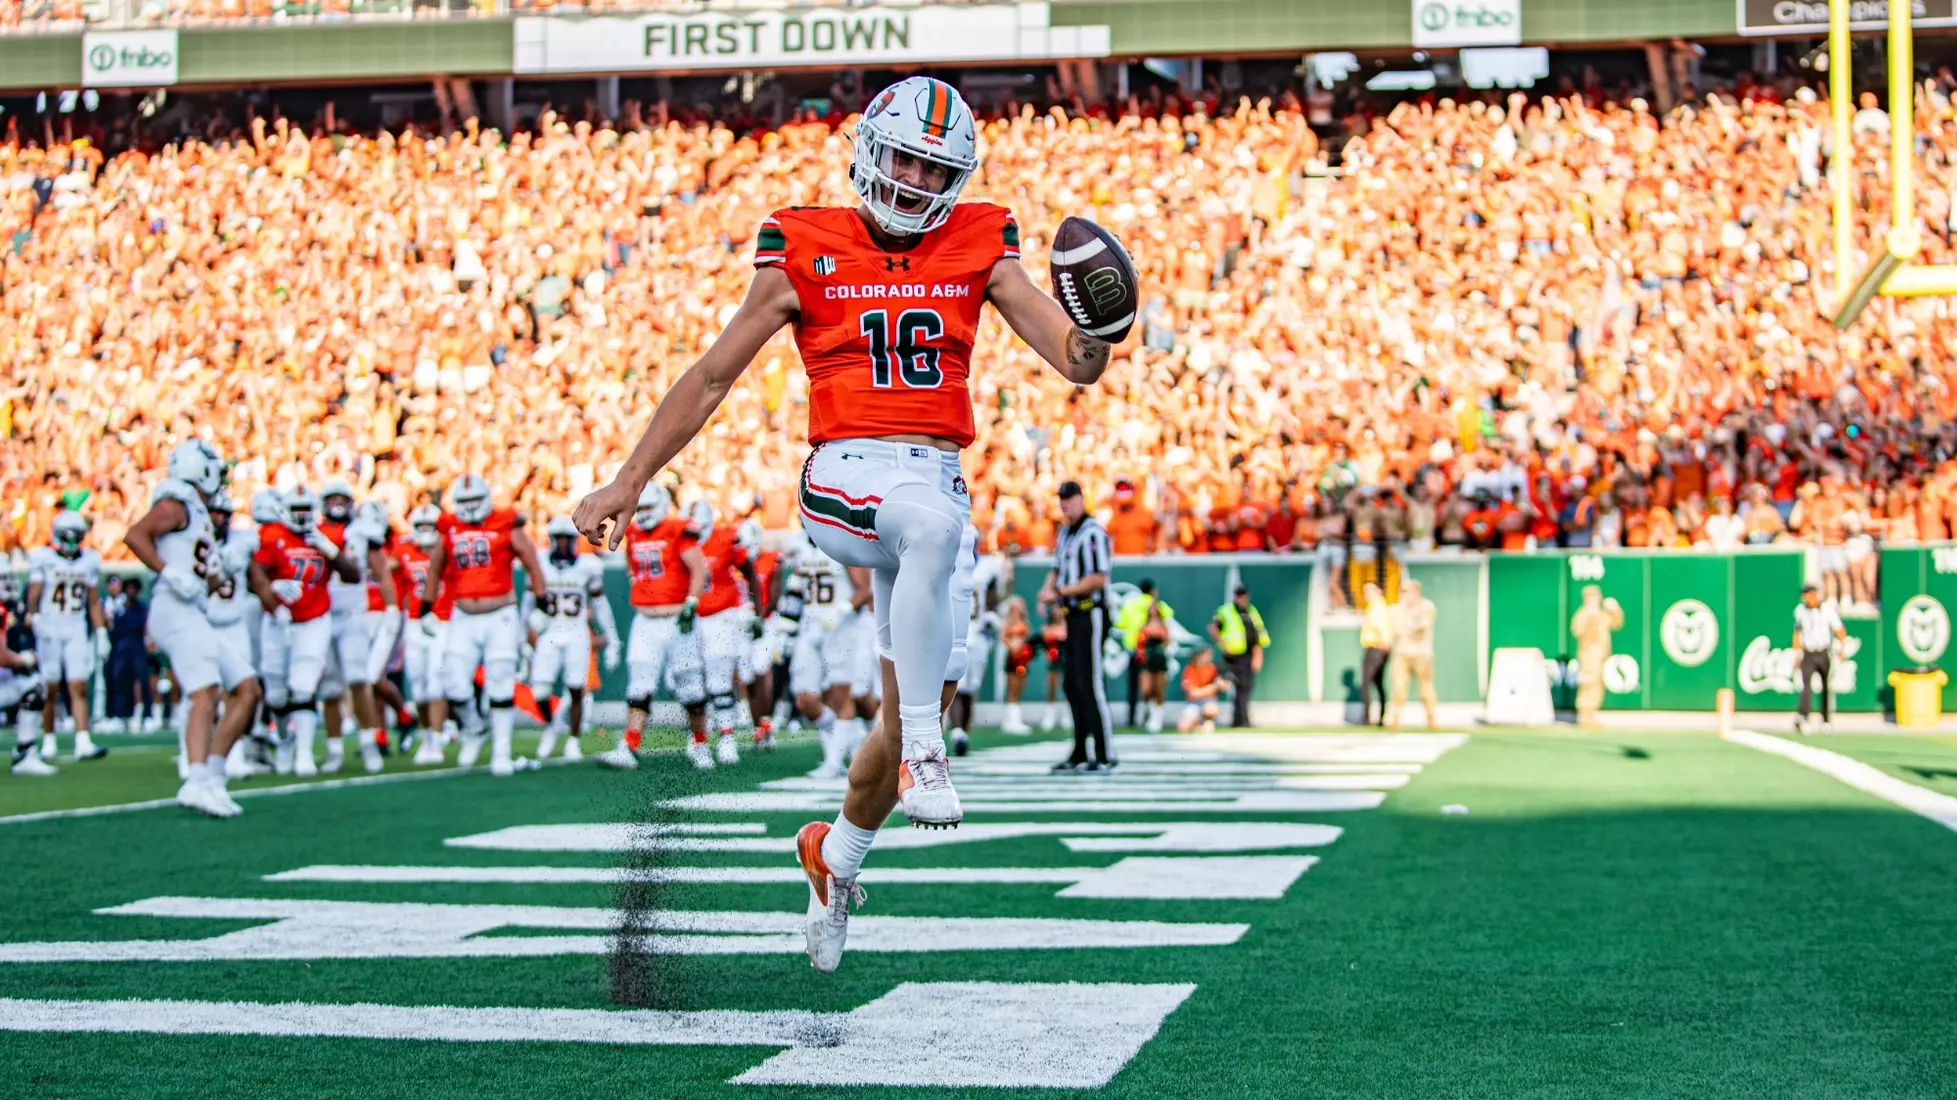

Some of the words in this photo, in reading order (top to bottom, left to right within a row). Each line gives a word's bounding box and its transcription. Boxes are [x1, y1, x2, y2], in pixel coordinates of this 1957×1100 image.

[643, 20, 766, 57] FIRST
[781, 16, 911, 53] DOWN
[824, 284, 925, 300] COLORADO
[930, 283, 969, 298] A&M
[860, 308, 945, 388] 16
[289, 556, 325, 590] 77
[52, 581, 87, 612] 49
